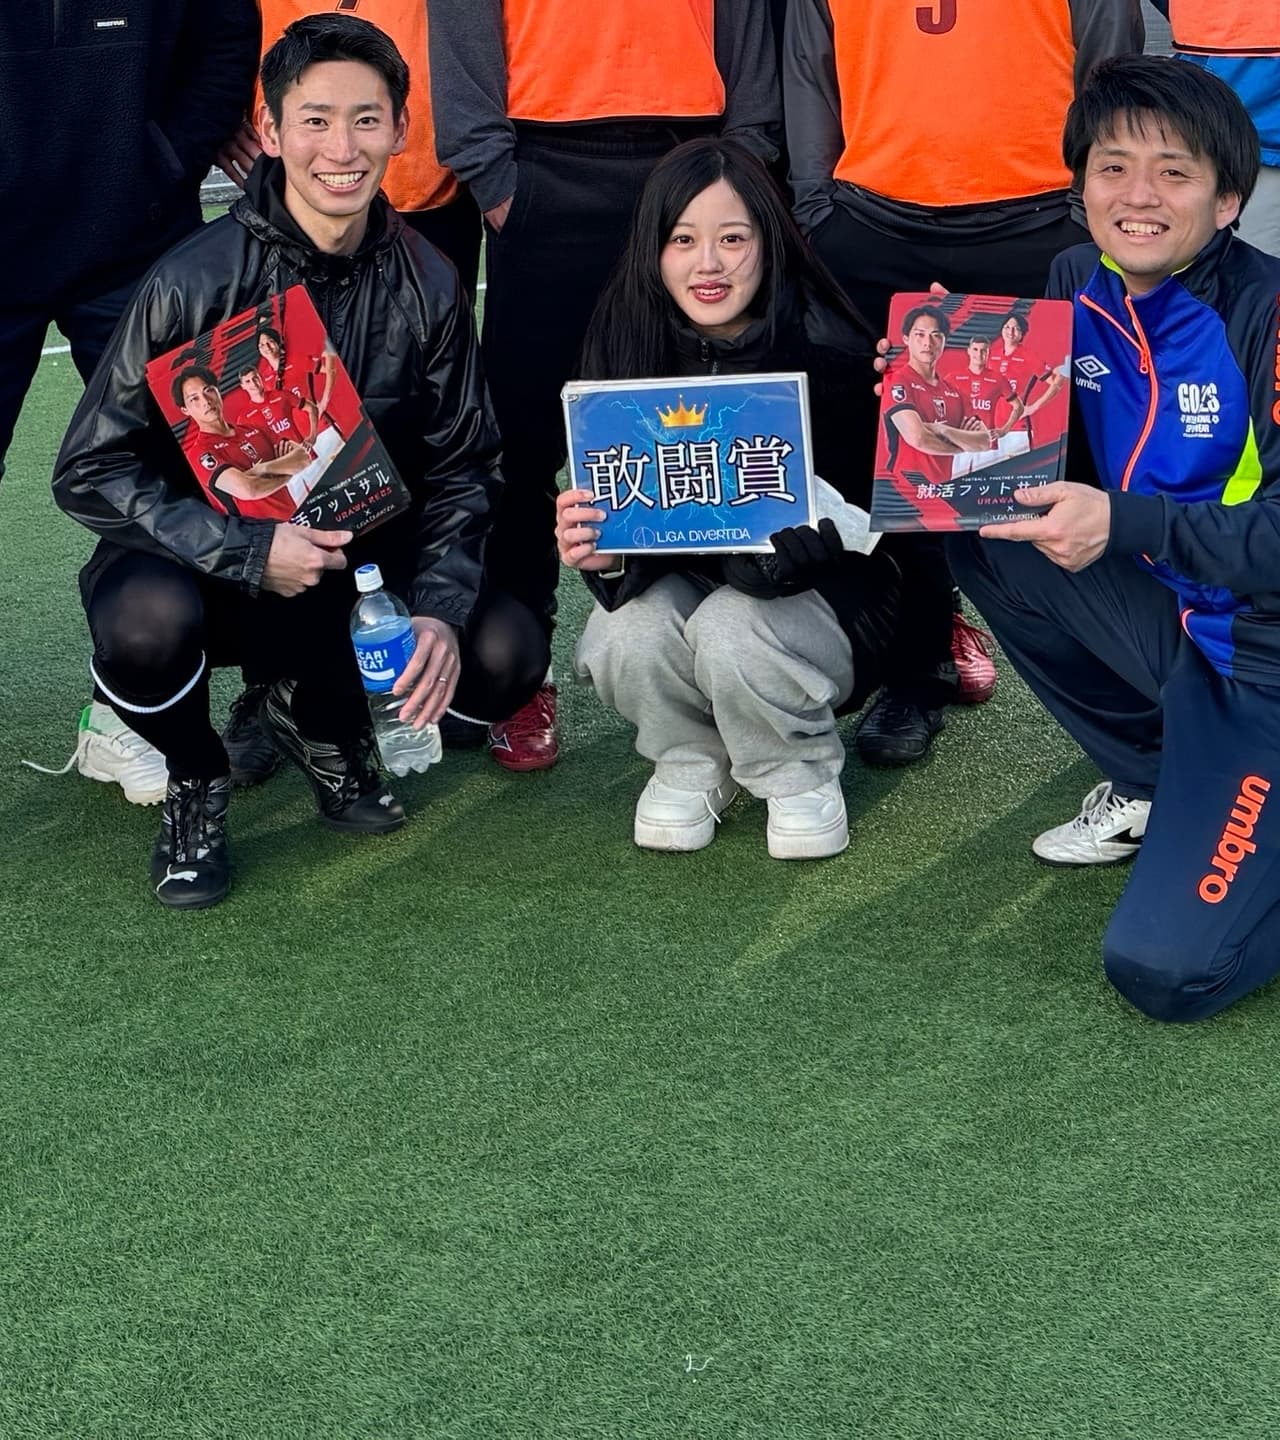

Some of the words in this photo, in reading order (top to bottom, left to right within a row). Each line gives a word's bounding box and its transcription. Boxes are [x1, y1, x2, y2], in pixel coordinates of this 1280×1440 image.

[1075, 377, 1102, 393] umbro
[584, 435, 796, 510] 敢闘賞
[1198, 775, 1271, 904] umbro
